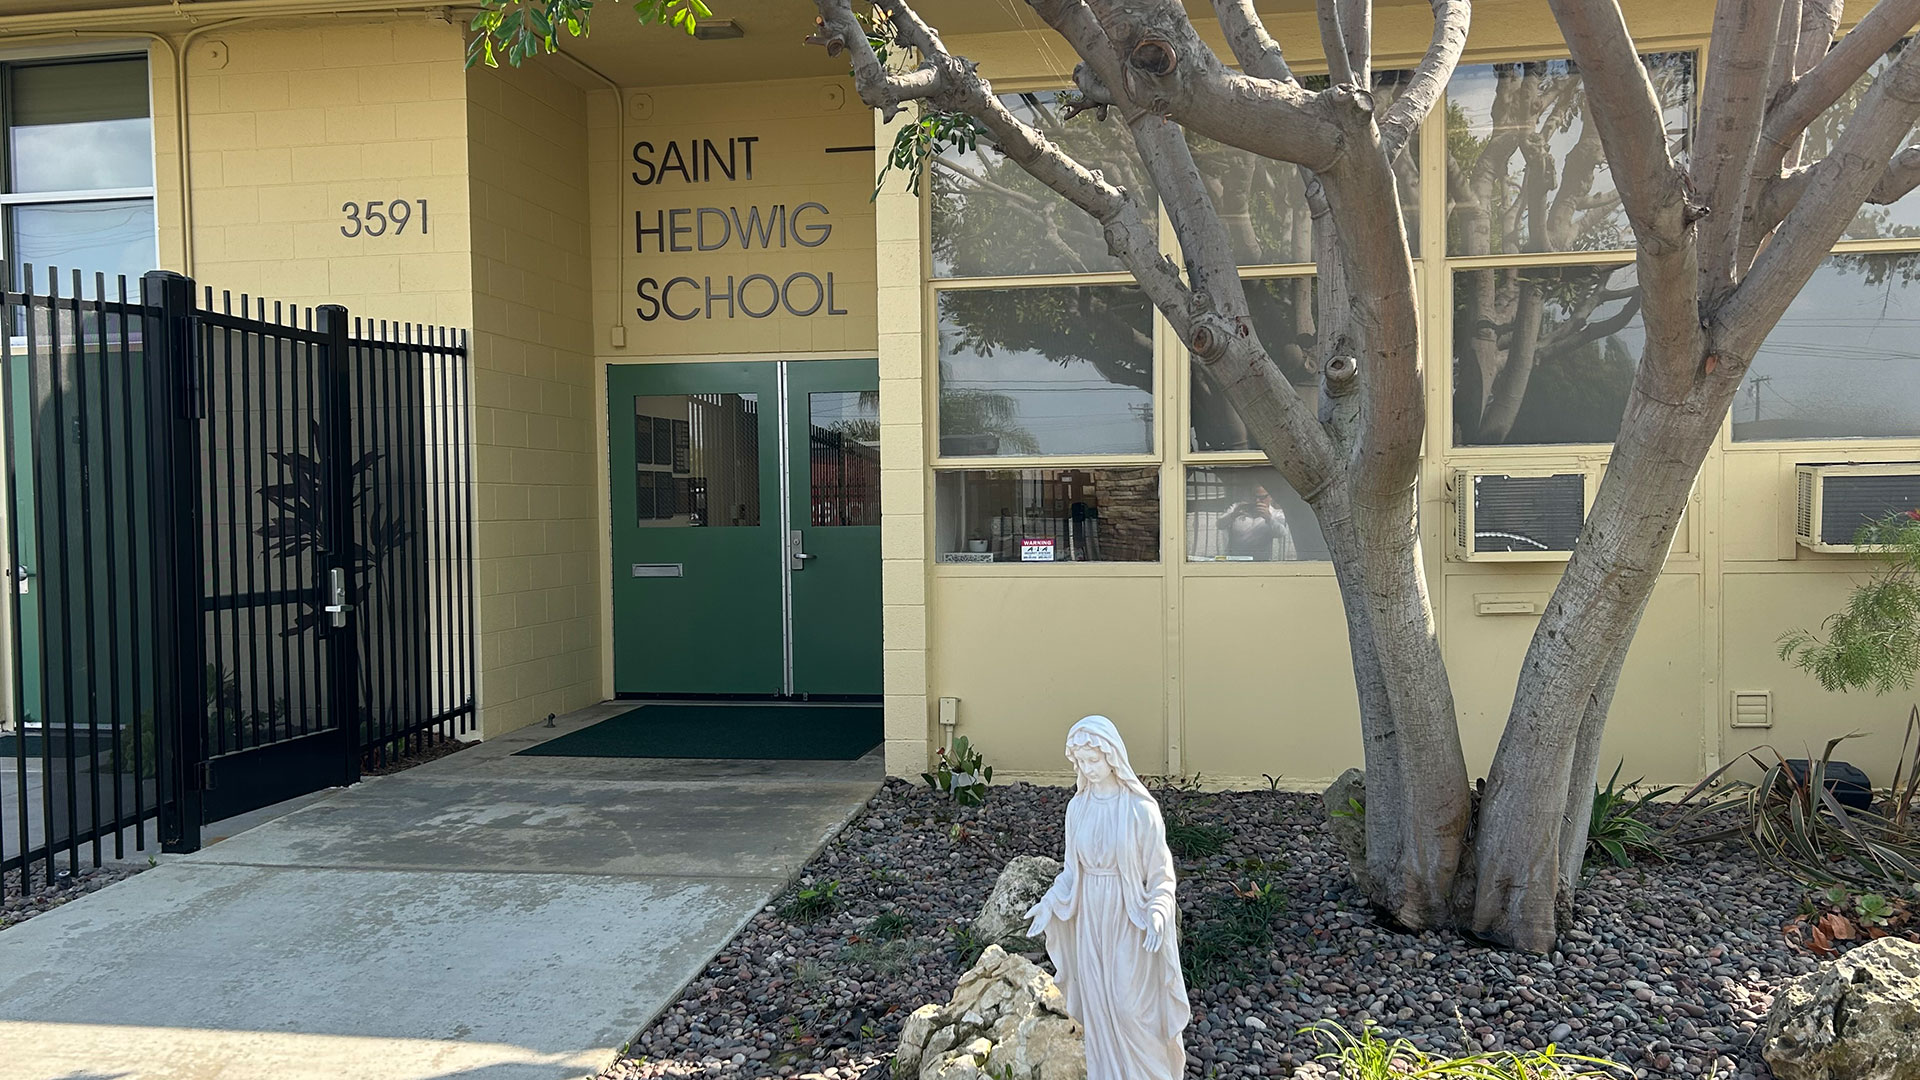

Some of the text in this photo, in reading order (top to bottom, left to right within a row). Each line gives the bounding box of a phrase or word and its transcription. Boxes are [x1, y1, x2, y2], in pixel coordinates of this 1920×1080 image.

[631, 136, 759, 185] SAINT
[340, 199, 427, 238] 3591
[635, 202, 832, 253] HEDWIG
[636, 272, 848, 321] SCHOOL
